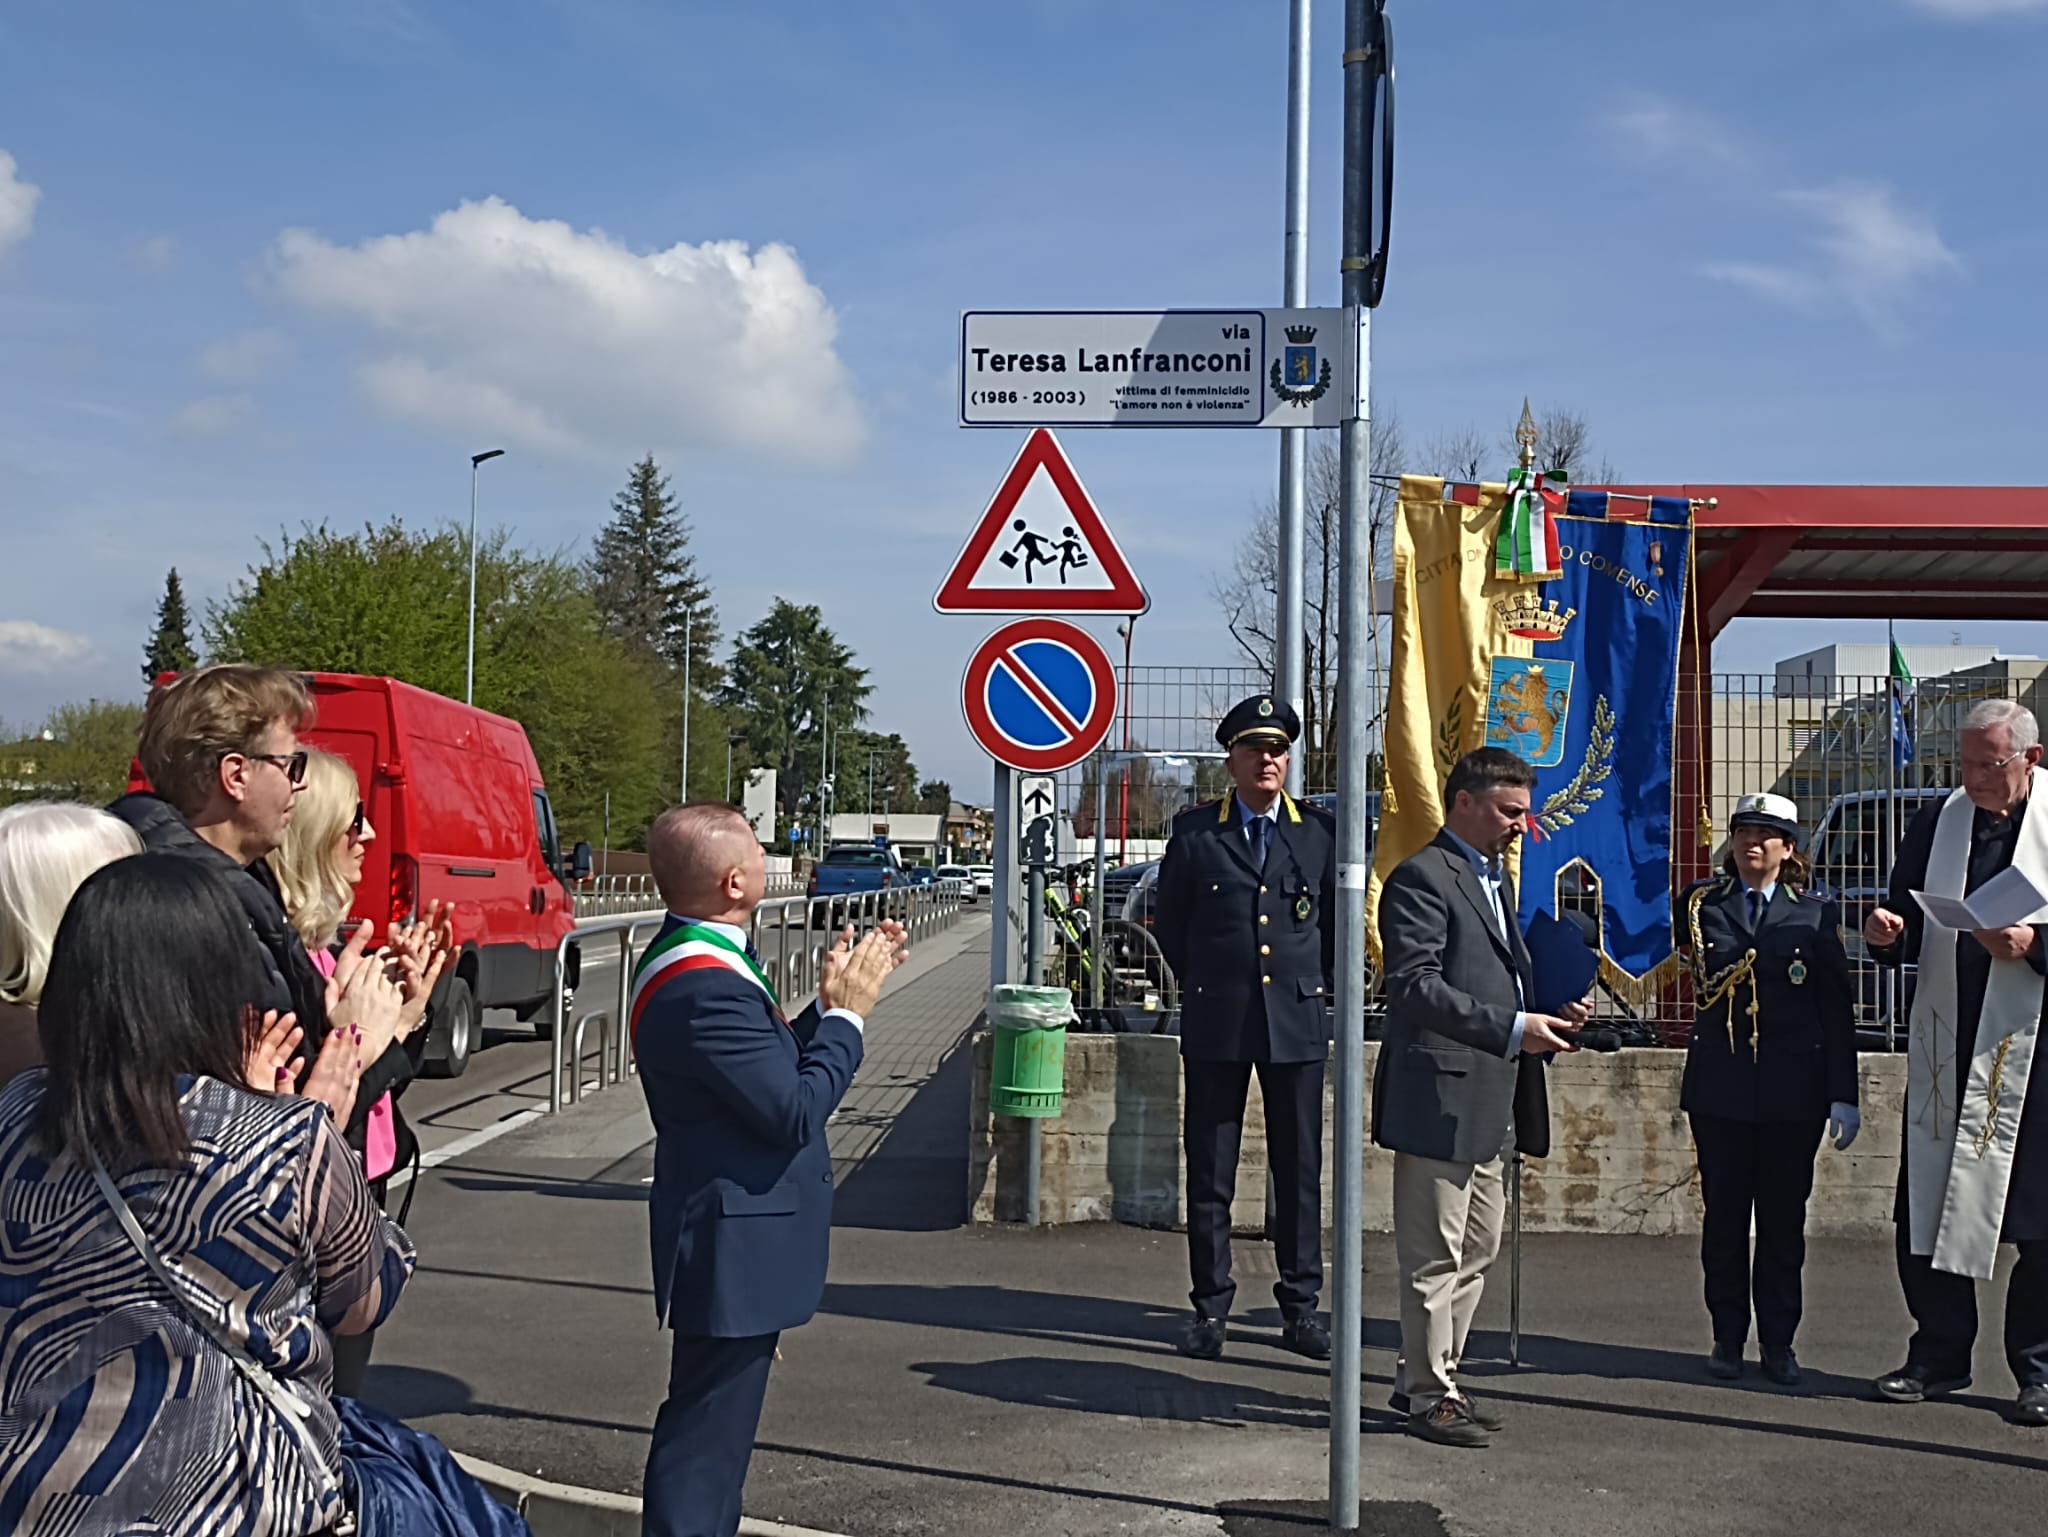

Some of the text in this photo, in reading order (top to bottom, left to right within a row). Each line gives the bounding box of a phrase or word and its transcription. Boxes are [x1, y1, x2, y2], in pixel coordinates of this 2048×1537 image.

[1222, 324, 1250, 340] via
[971, 347, 1251, 373] Teresa Lanfranconi
[971, 390, 1018, 406] (1986
[1033, 390, 1086, 406] 2003)
[1115, 385, 1250, 396] vittima di femminicidio
[1161, 401, 1182, 410] non
[1196, 400, 1250, 410] violenza"
[1579, 550, 1661, 607] COMENSE
